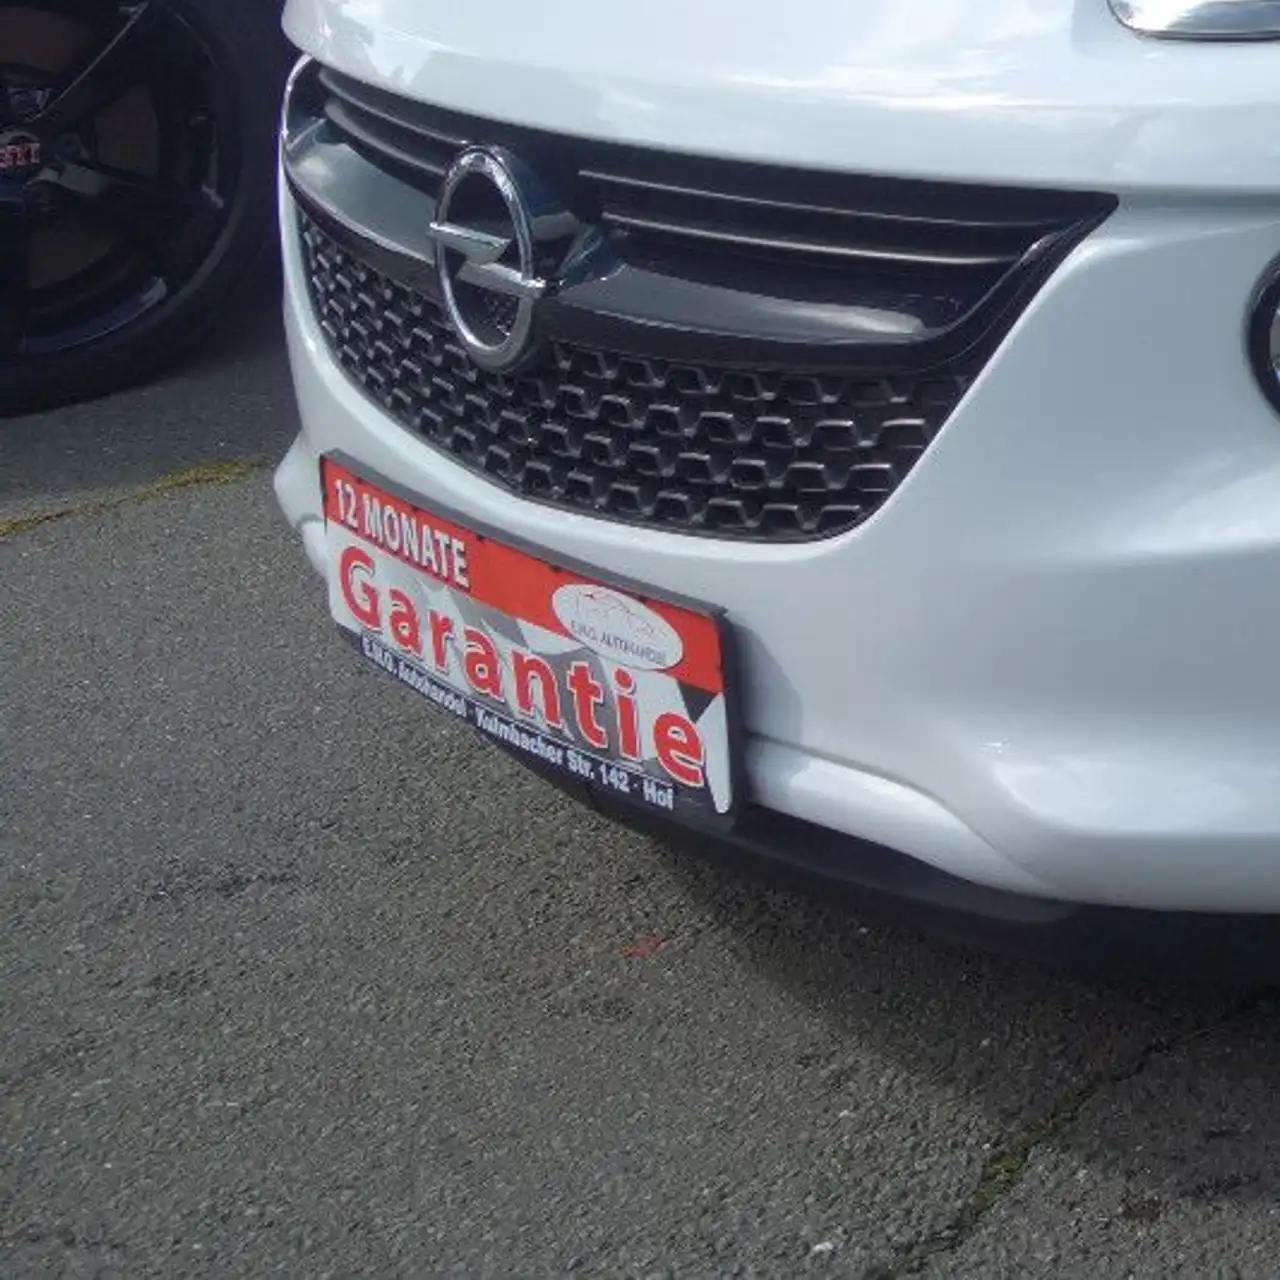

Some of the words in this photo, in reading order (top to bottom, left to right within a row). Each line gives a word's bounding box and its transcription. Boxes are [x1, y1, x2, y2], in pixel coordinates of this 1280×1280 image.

[334, 478, 359, 528] 12
[362, 492, 469, 589] MONATE
[338, 544, 706, 788] Garantie
[566, 748, 596, 781] Str.
[600, 762, 631, 794] 142
[643, 776, 675, 811] Hof
